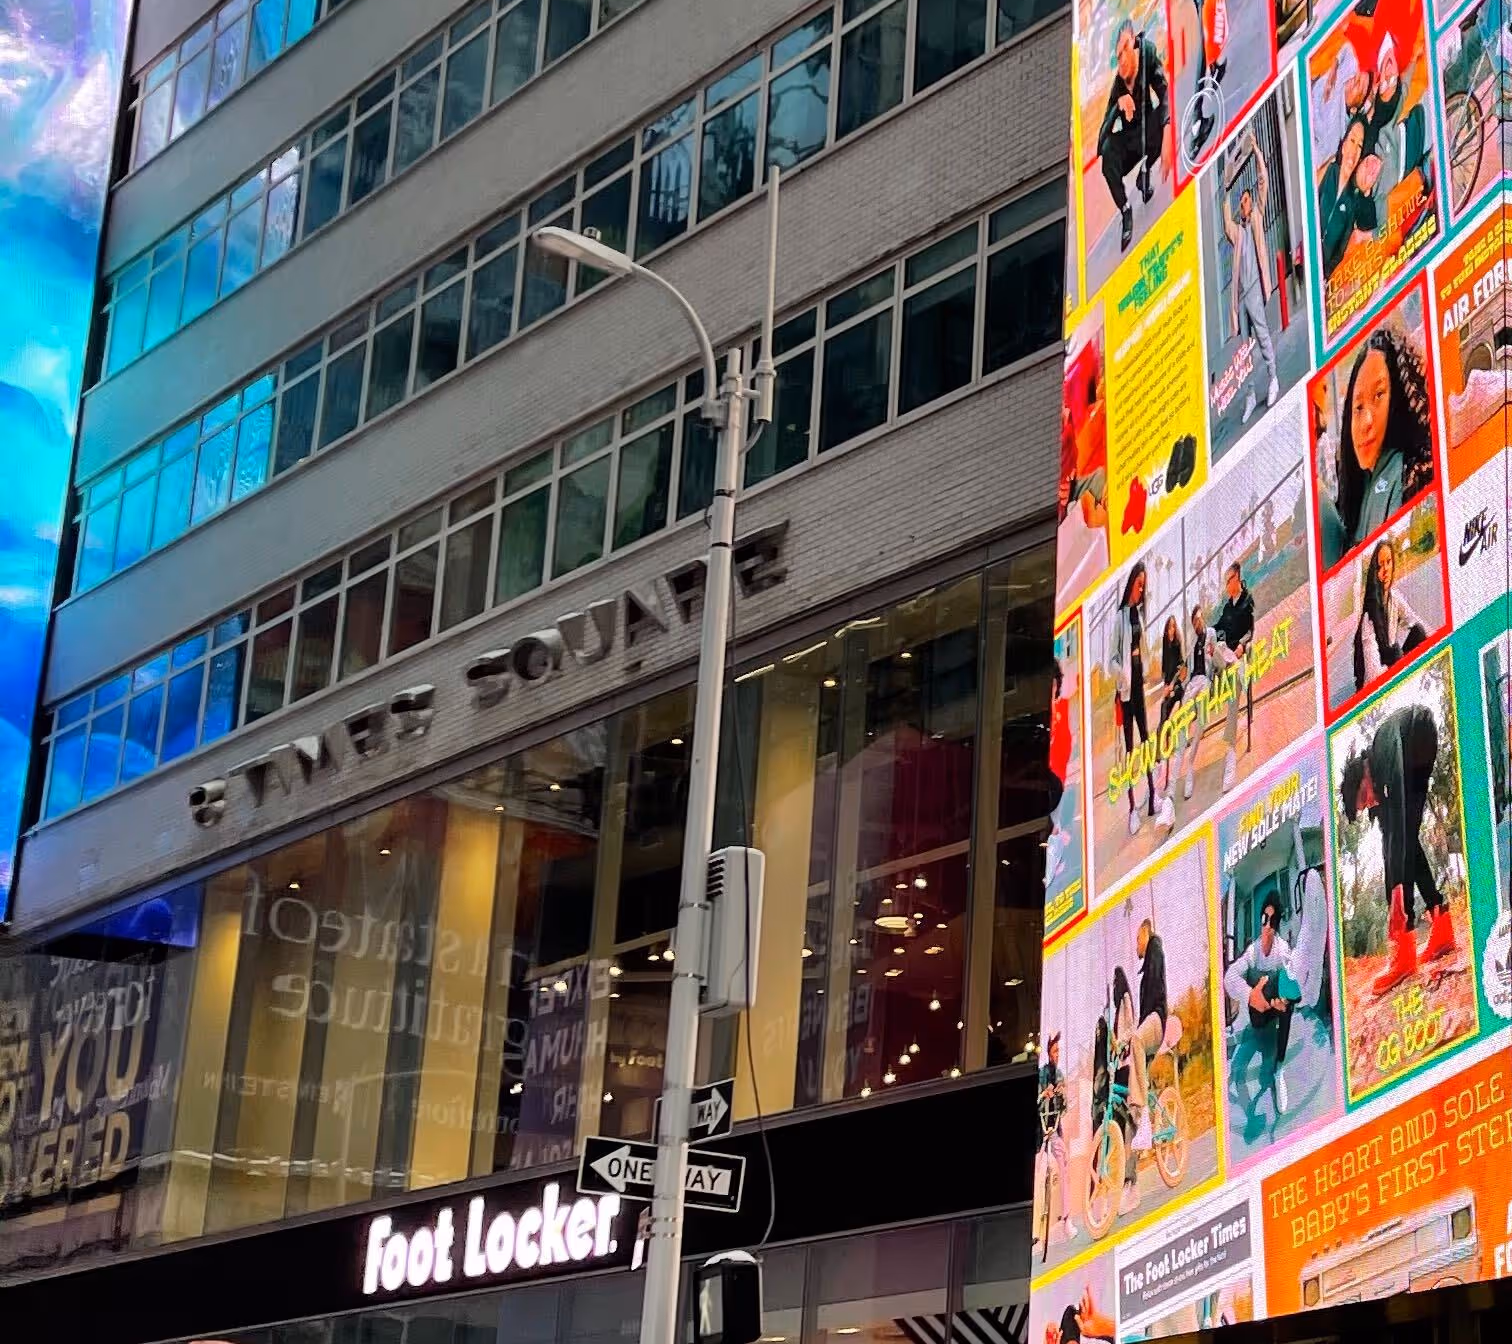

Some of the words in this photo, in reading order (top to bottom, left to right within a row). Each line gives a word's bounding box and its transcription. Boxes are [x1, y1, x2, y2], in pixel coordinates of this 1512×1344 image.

[1328, 288, 1345, 314] TO
[1443, 293, 1470, 338] AIR
[1480, 522, 1498, 555] AIR
[1108, 732, 1157, 804] SHOW
[1160, 699, 1196, 759] OFF
[1196, 663, 1238, 726] THAT
[1243, 617, 1293, 690] HEAT
[1224, 831, 1249, 872] NEW
[1251, 807, 1280, 850] SOLE
[1392, 985, 1424, 1024] THE
[1376, 1032, 1400, 1070] OG
[1403, 1006, 1445, 1056] BOOT
[608, 1157, 653, 1182] ONE
[1269, 1175, 1308, 1219] THE
[1314, 1135, 1383, 1197] HEART
[1390, 1109, 1437, 1156] AND
[1444, 1070, 1505, 1128] SOLE
[1291, 1183, 1370, 1248] BABY'S
[1378, 1142, 1449, 1206] FIRST
[362, 1207, 455, 1294] Foot
[1123, 1271, 1144, 1295] The
[1145, 1253, 1170, 1285] Foot
[1171, 1236, 1209, 1271] Locker
[1211, 1216, 1247, 1249] Times
